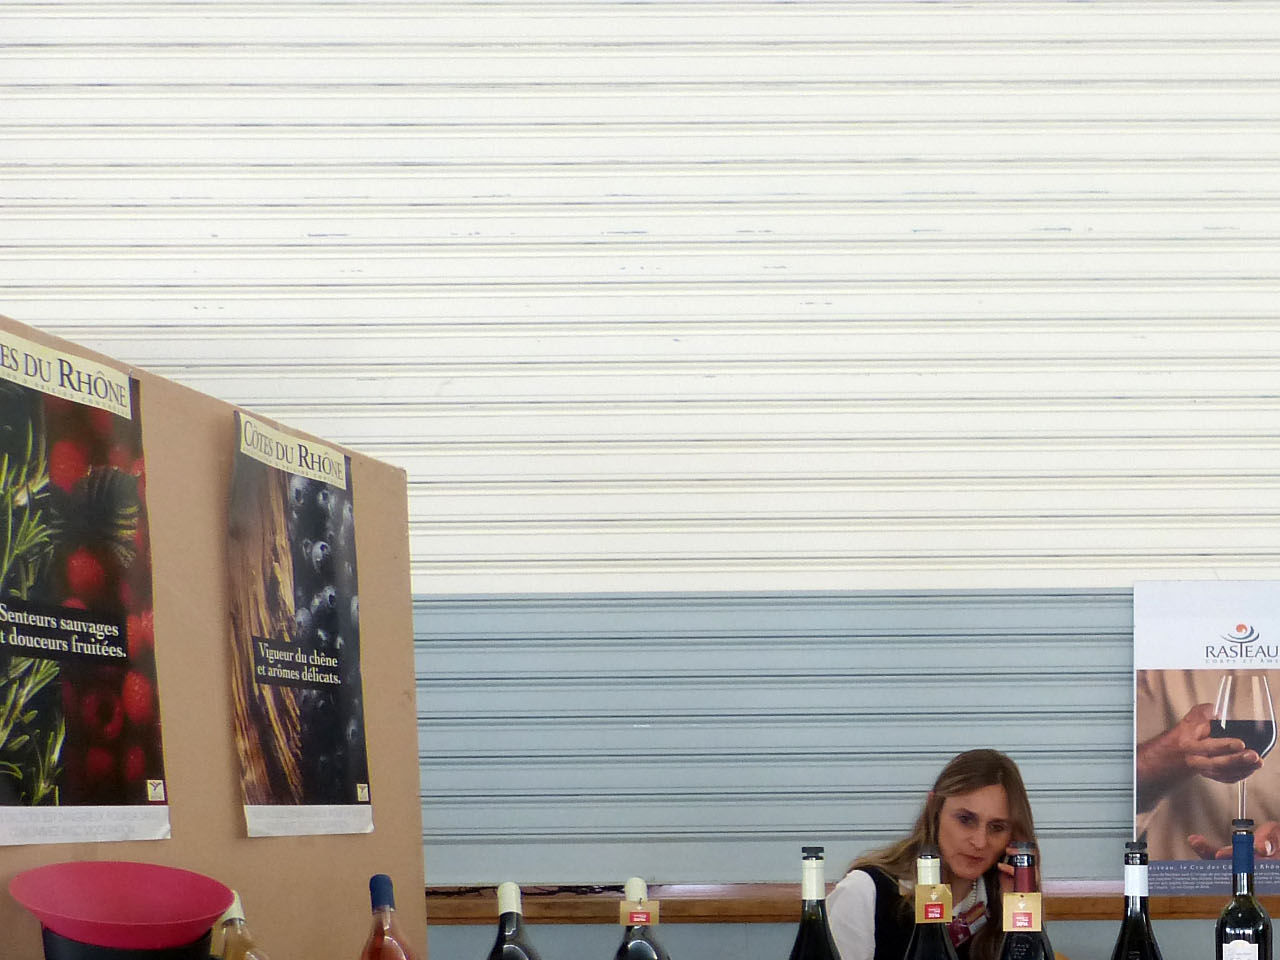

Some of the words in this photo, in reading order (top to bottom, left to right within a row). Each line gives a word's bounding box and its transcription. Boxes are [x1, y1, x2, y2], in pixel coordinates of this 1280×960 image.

[0, 343, 19, 372] ES
[24, 352, 52, 383] DU
[57, 358, 127, 408] RHÔNE
[244, 420, 273, 457] CÔTES
[276, 441, 294, 464] DU
[297, 443, 343, 481] RHÔNE
[0, 603, 57, 628] Senteurs
[60, 618, 119, 640] sauvages
[9, 626, 68, 652] douceurs
[71, 634, 127, 658] fruitées.
[258, 642, 294, 663] Vigueur
[295, 647, 307, 664] du
[309, 649, 338, 667] chêne
[1205, 642, 1279, 658] RASTEAU
[257, 665, 266, 676] et
[267, 663, 300, 680] arômes
[301, 665, 341, 684] délicats.
